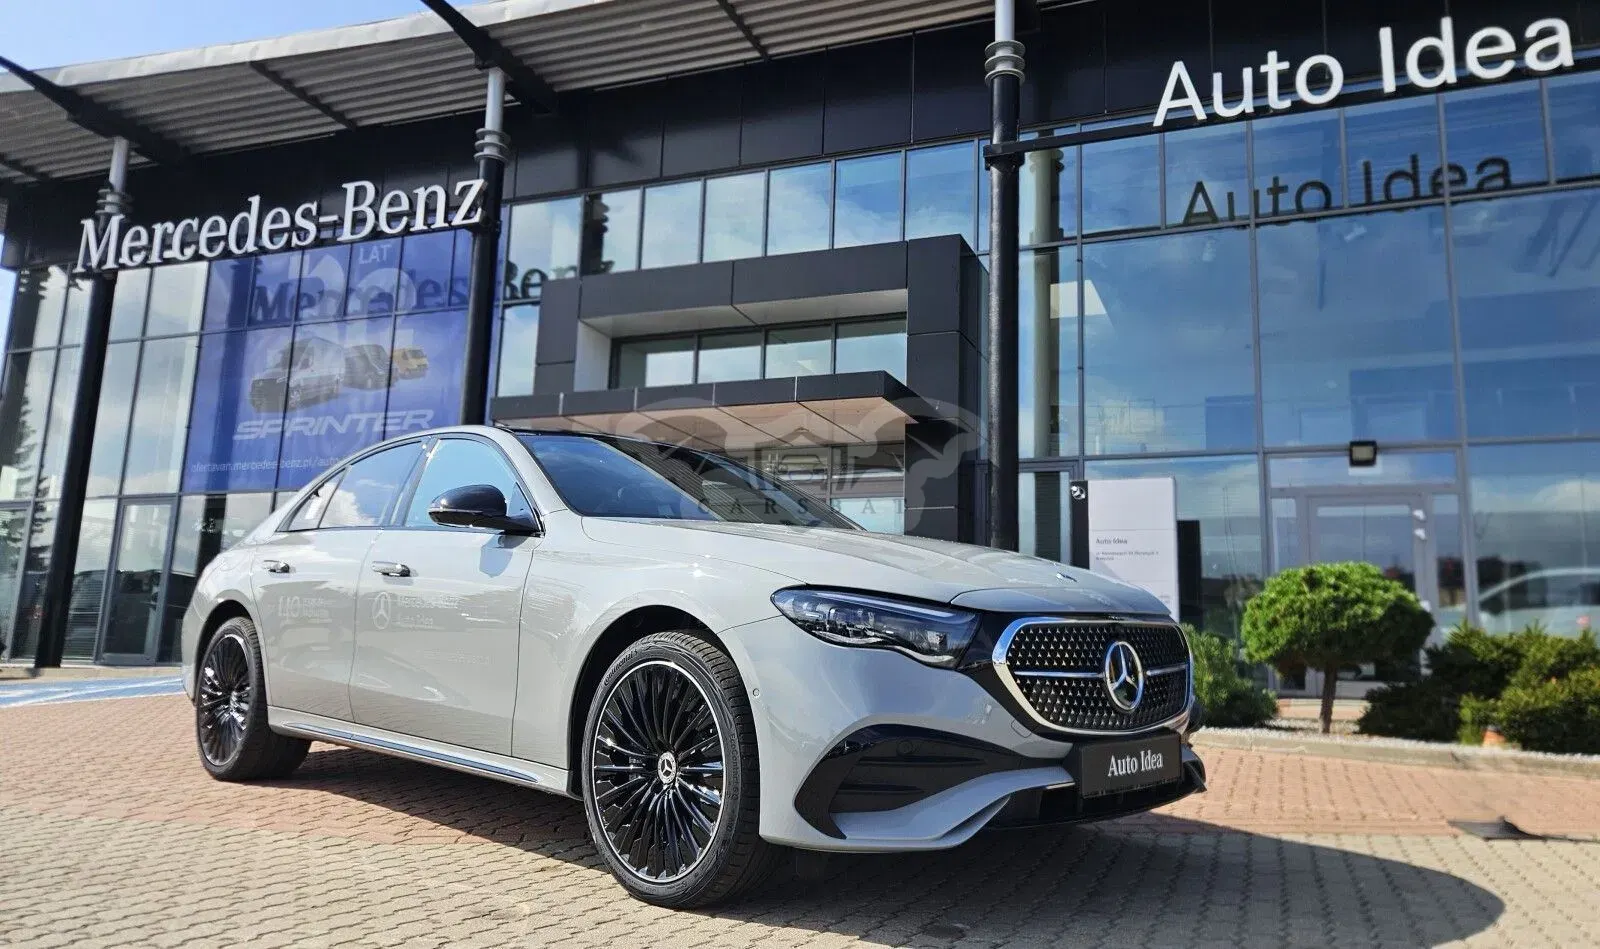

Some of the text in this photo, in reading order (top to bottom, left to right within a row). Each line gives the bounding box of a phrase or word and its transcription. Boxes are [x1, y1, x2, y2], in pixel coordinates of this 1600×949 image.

[1153, 16, 1575, 127] Auto Idea
[1183, 153, 1513, 229] Auto Idea
[76, 178, 486, 273] Mercedes-Benz
[358, 244, 394, 265] LAT
[233, 408, 435, 442] SPRINTER
[1108, 749, 1164, 777] Auto Idea
